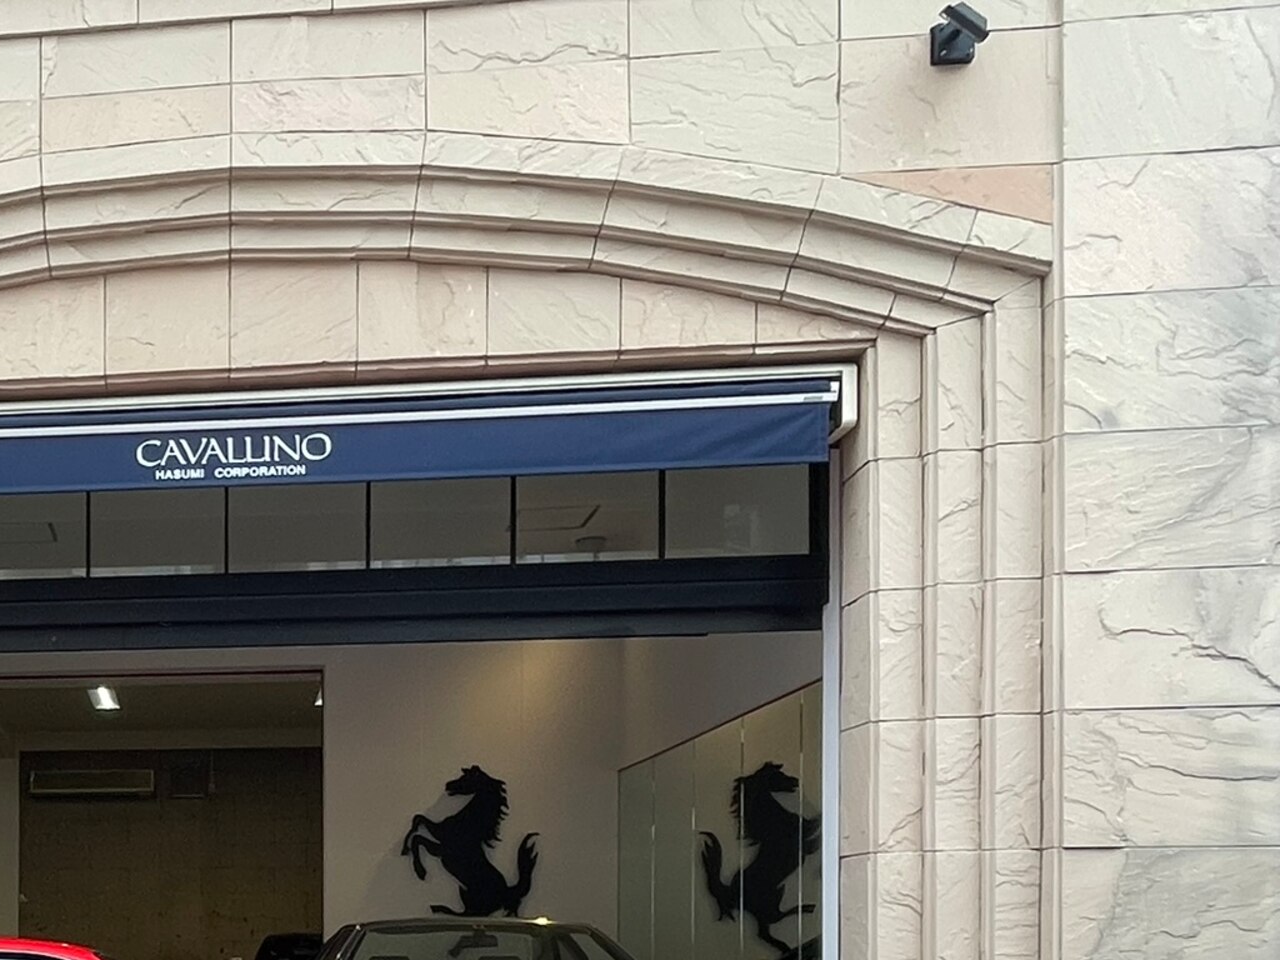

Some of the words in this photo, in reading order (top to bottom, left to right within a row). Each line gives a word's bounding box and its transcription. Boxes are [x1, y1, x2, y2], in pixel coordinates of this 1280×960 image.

[135, 432, 332, 467] CAVALLINO
[155, 467, 205, 480] HASUMI
[213, 464, 306, 479] CORPORATION
